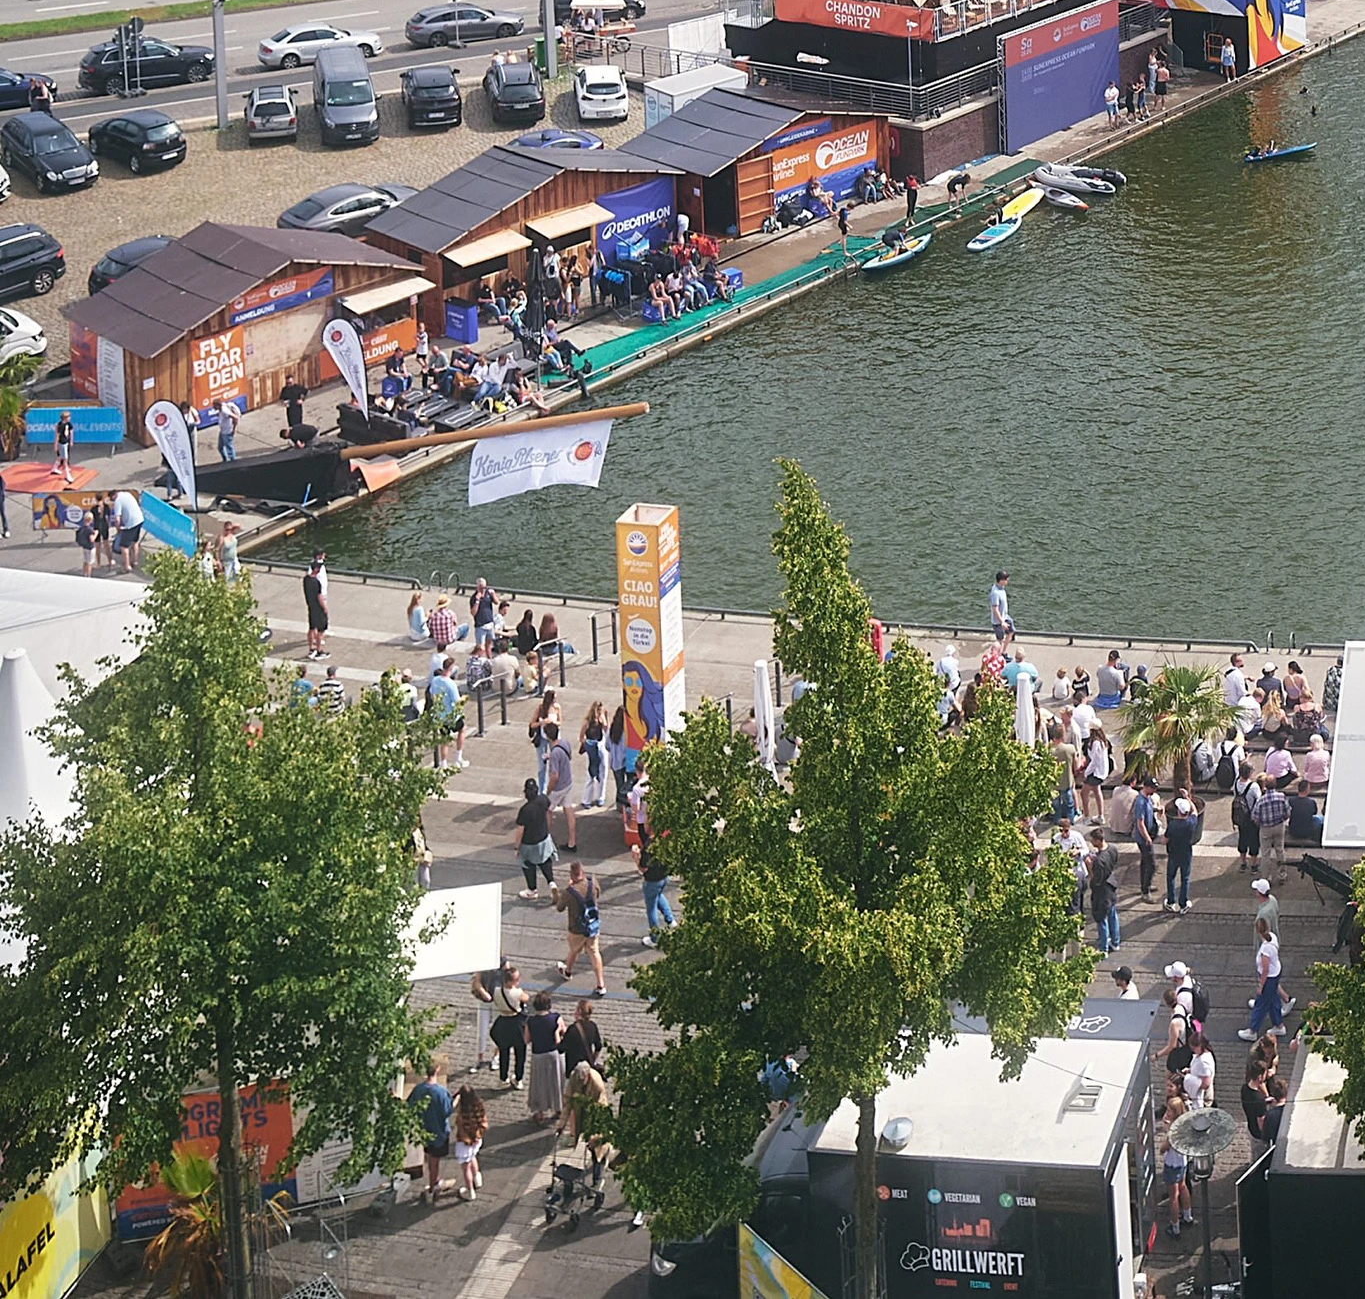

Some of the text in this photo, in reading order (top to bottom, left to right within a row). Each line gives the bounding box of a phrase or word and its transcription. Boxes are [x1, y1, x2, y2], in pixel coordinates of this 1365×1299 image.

[825, 0, 881, 20] CHANDON
[834, 12, 871, 30] SPRITZ
[1020, 37, 1033, 51] Sa
[834, 129, 869, 151] OCEAN
[617, 205, 671, 234] DECATHLON
[235, 303, 276, 322] ANMELDUNG
[199, 331, 233, 355] FLY
[363, 339, 399, 360] ELDUNG
[193, 347, 242, 377] BOAR
[208, 362, 245, 390] DEN
[471, 446, 562, 480] König Pilsener
[623, 579, 653, 594] CIAO
[621, 593, 658, 609] GRAU!
[892, 1189, 1037, 1207] MEAT VEGETARIAN VEGAN
[932, 1248, 1025, 1277] GRILLWERFT
